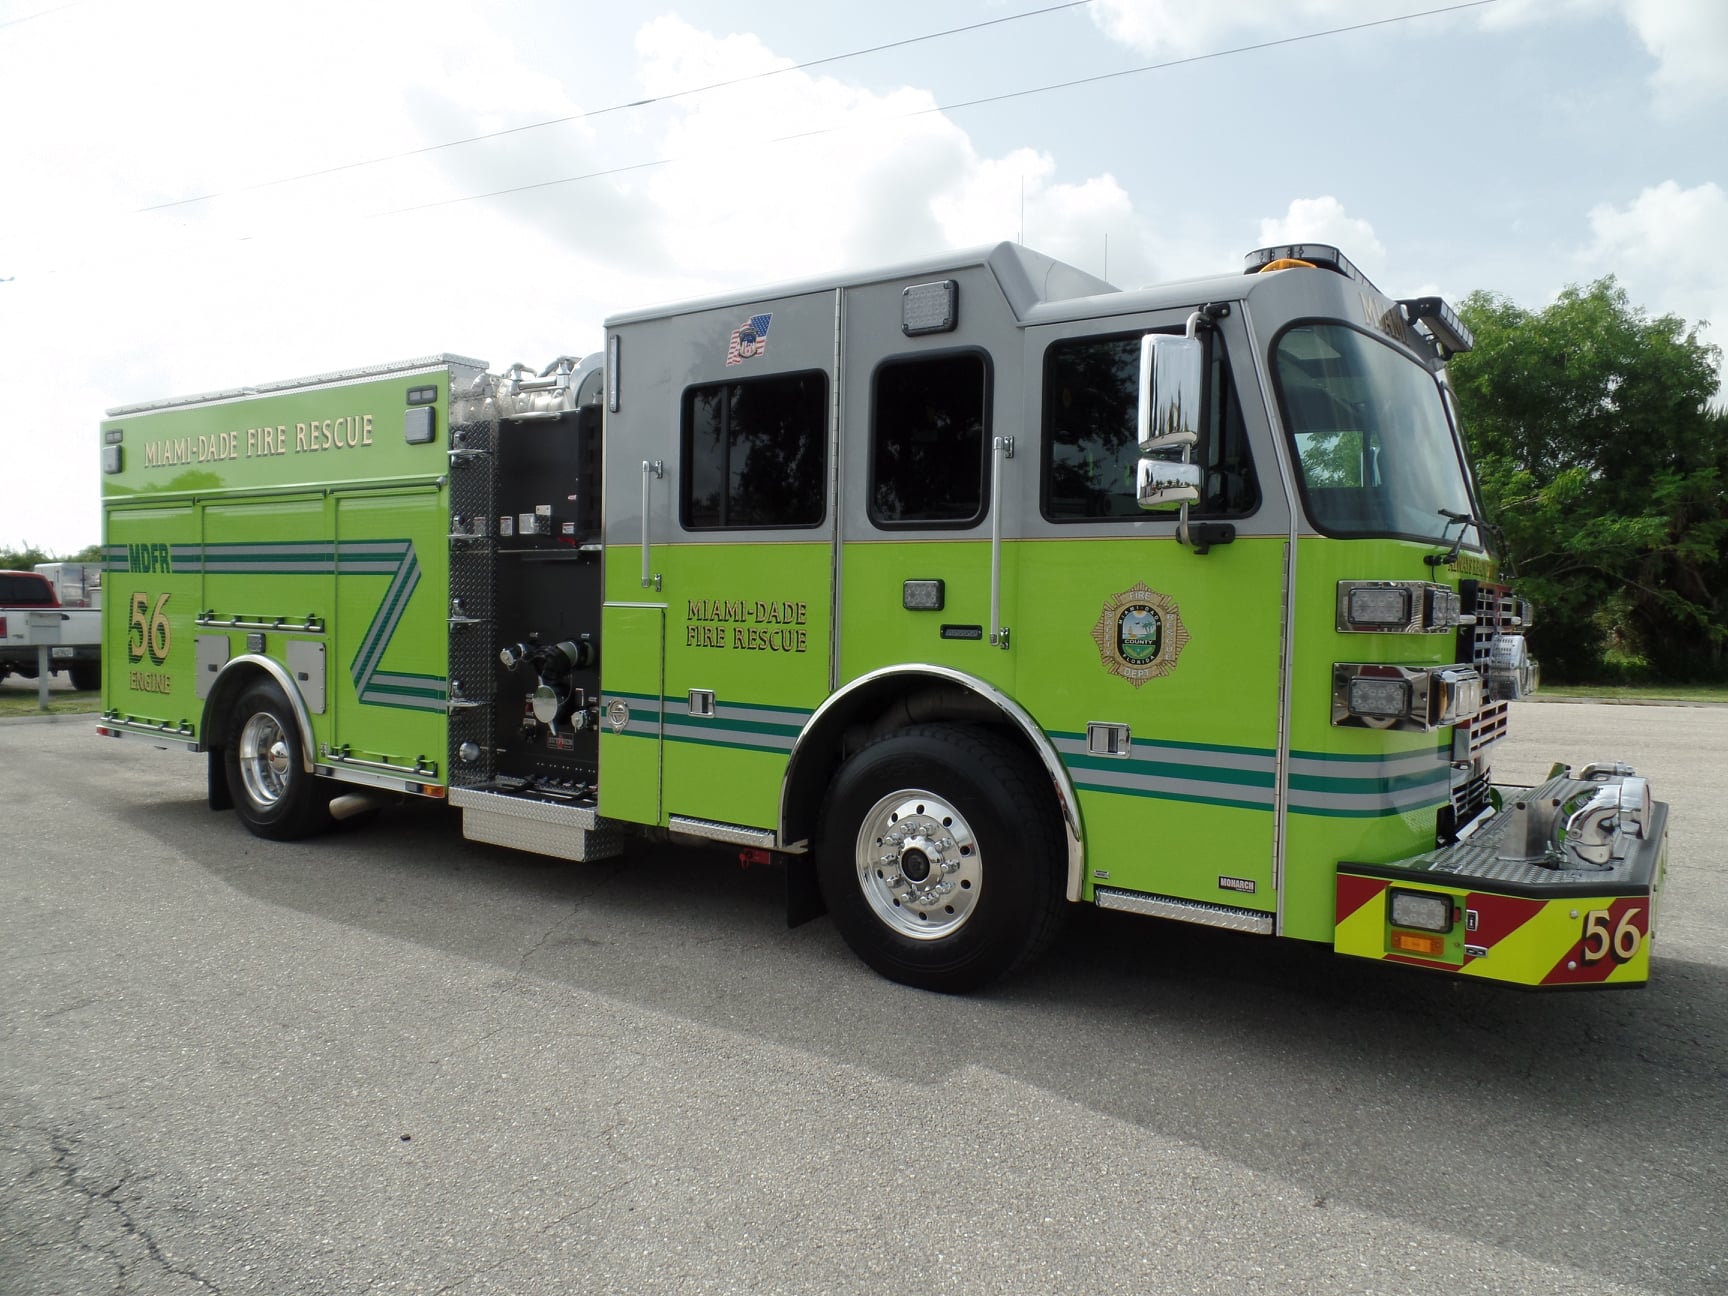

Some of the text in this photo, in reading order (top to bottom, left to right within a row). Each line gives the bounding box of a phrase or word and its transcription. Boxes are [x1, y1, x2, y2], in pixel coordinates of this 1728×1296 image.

[144, 414, 374, 468] MIAMI-DADE FIRE RESCUE
[127, 543, 171, 573] MDFR
[1128, 591, 1152, 601] FIRE
[687, 599, 807, 625] MIAMI-DADE
[128, 592, 172, 666] 56
[686, 625, 807, 652] FIRE RESCUE
[1105, 611, 1115, 656] SAFETY
[1165, 613, 1175, 660] RESCUE
[1122, 653, 1155, 665] FLORIDA
[129, 671, 171, 694] ENGINE
[1123, 668, 1150, 678] DEPT
[1221, 878, 1254, 890] MONARCH
[1581, 907, 1645, 965] 56
